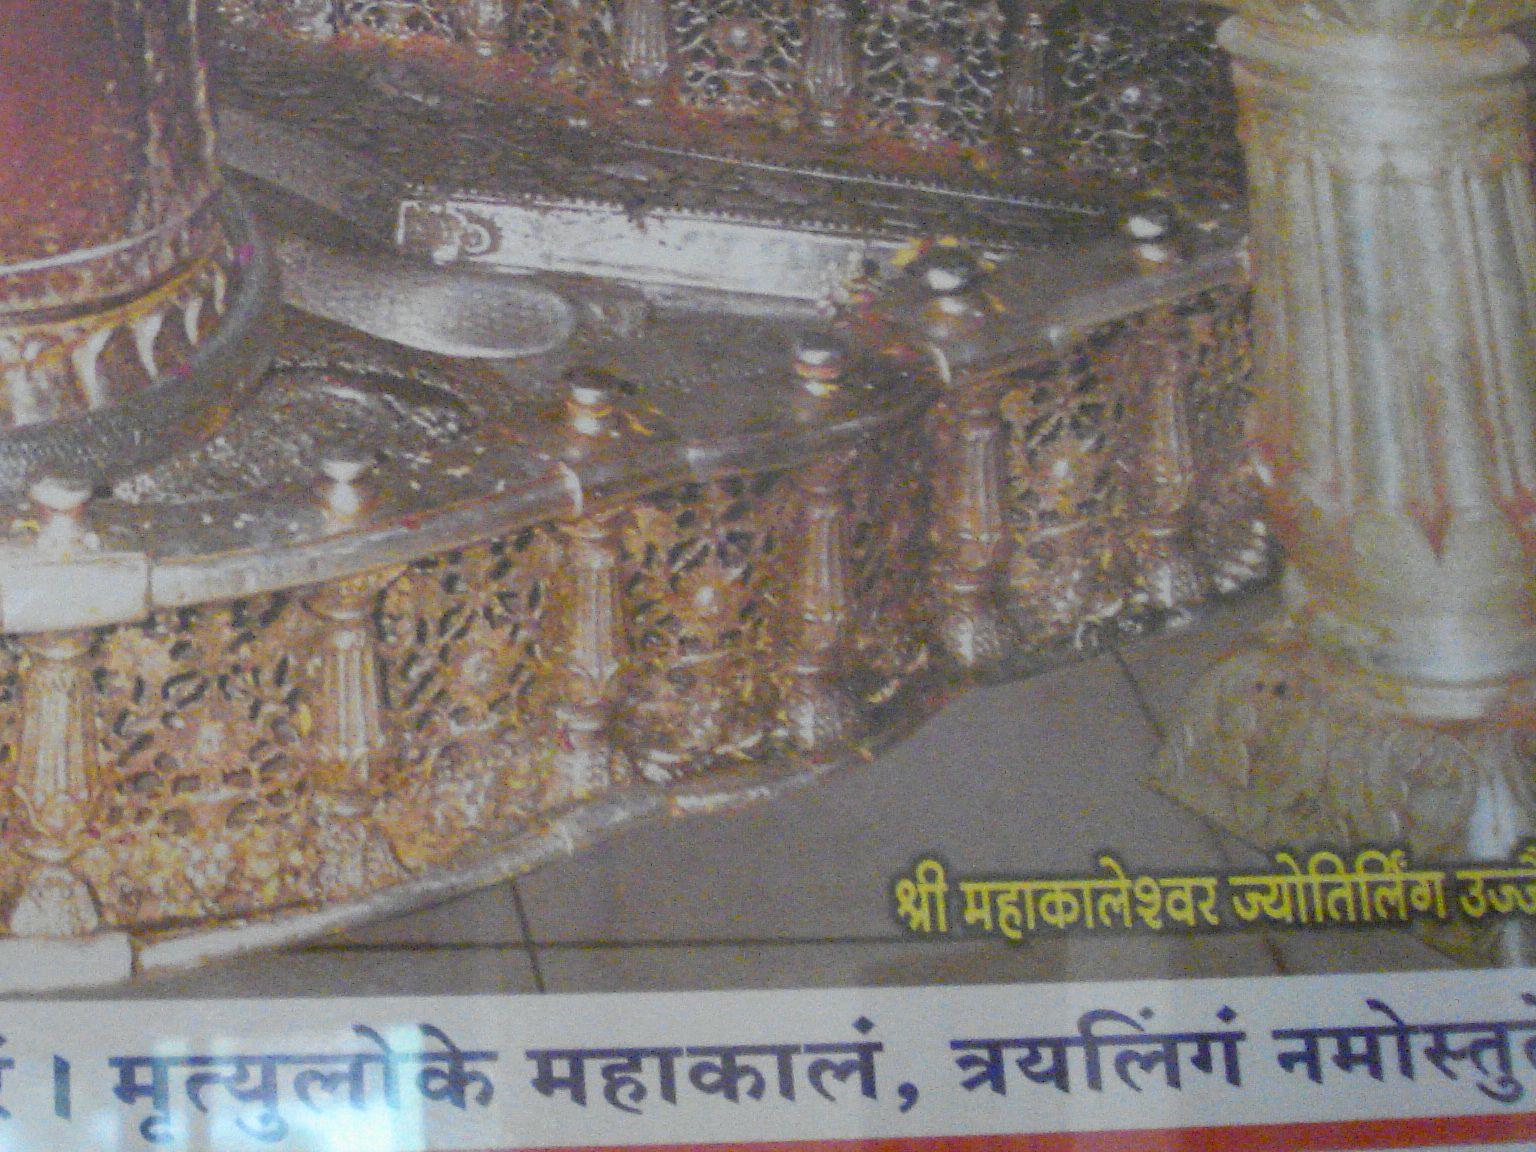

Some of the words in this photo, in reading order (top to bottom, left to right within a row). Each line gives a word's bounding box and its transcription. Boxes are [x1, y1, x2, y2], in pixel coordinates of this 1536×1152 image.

[895, 858, 949, 934] श्री
[960, 855, 1221, 940] महाकालेश्वर
[1227, 849, 1446, 924] ज्योतिर्लिंग
[108, 1023, 498, 1143] मृत्युलोके
